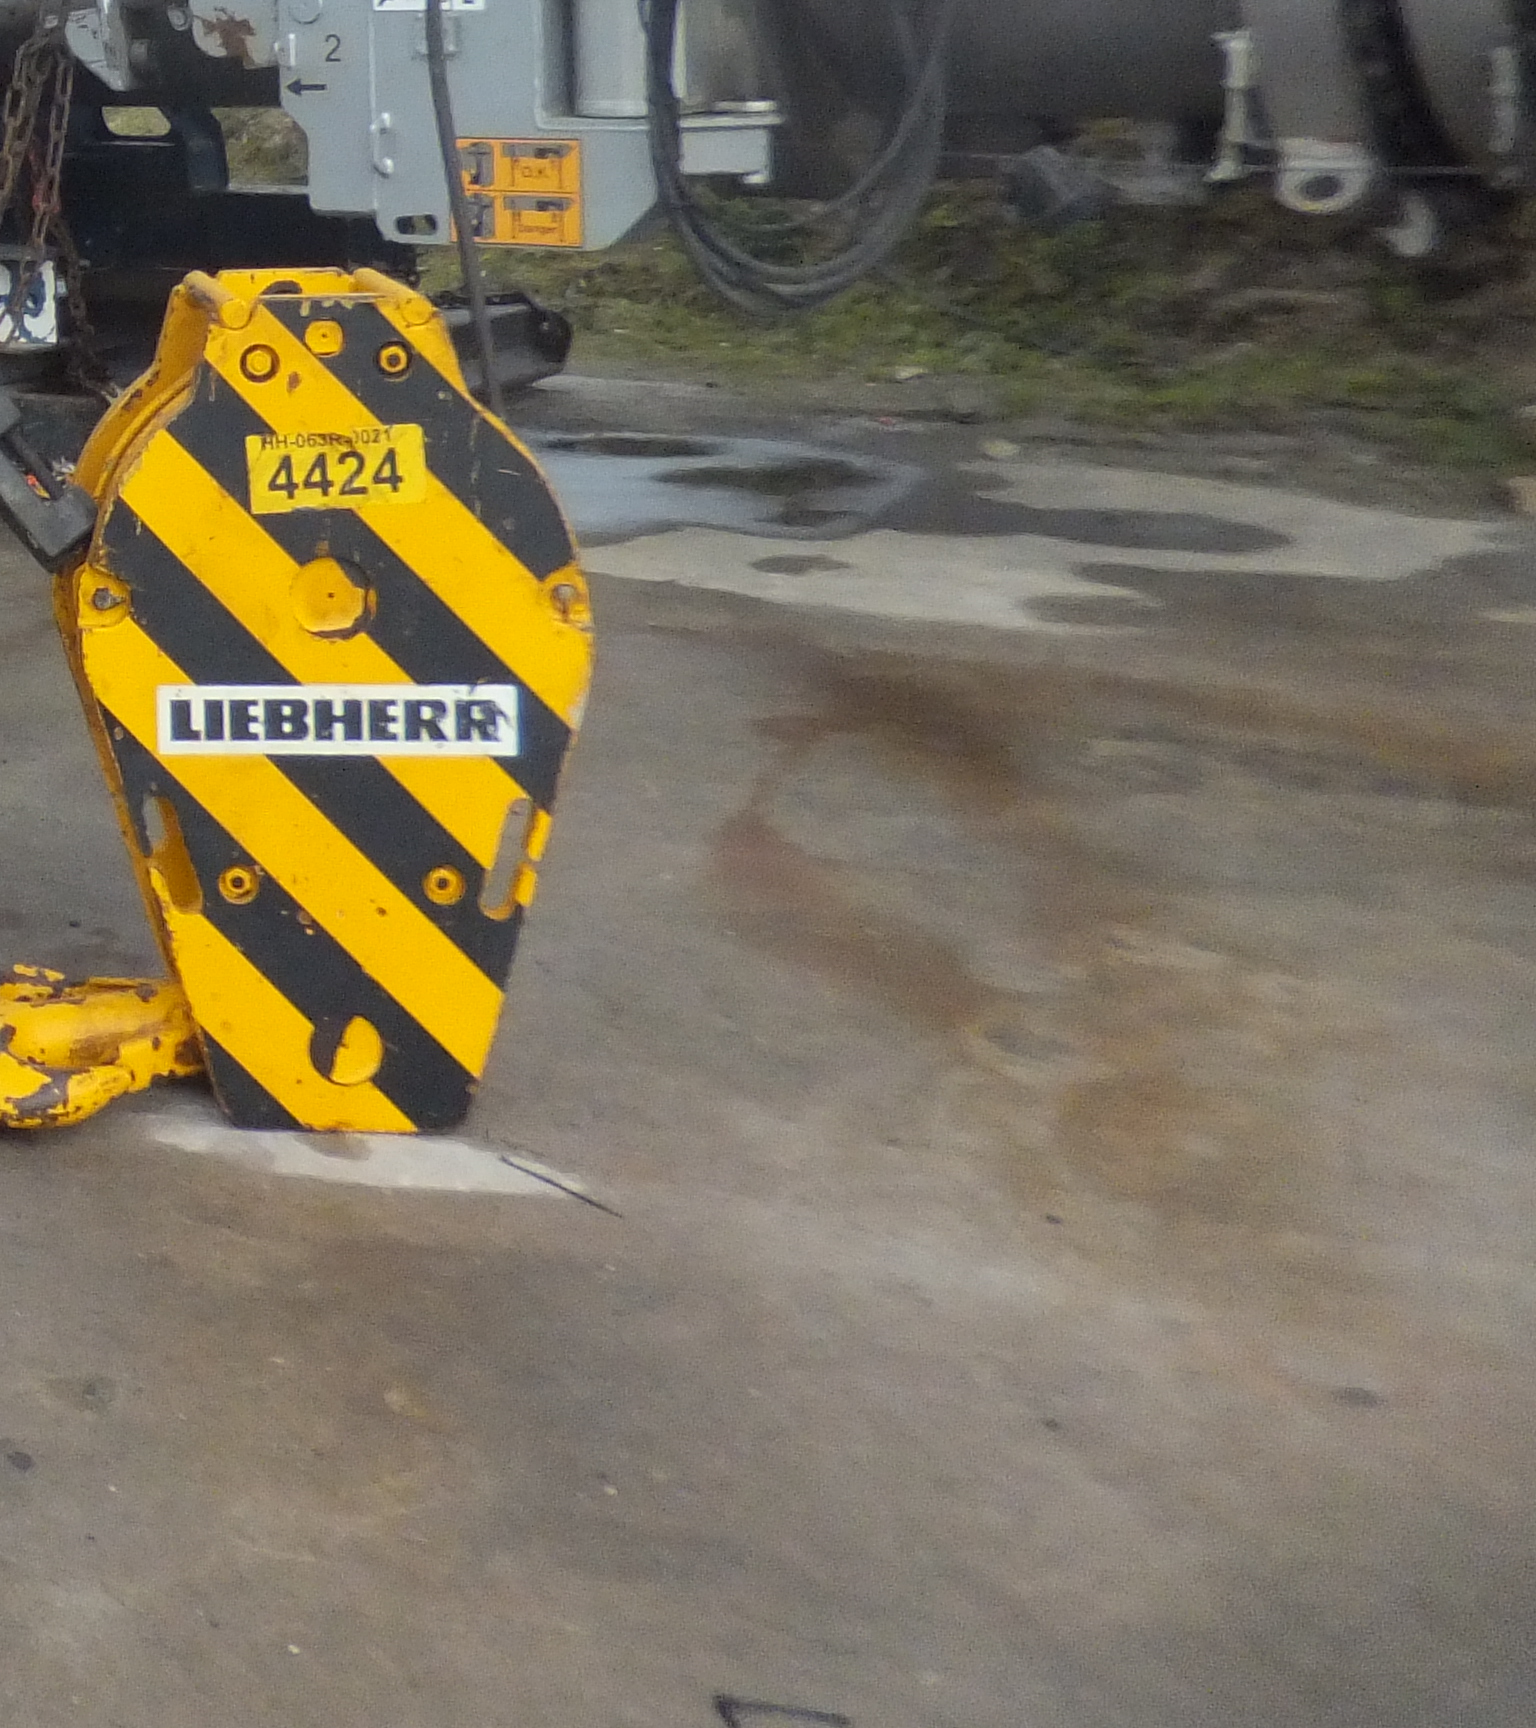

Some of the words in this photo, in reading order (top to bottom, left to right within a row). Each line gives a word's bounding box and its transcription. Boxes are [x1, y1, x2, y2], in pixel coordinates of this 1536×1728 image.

[324, 34, 342, 62] 2
[268, 448, 404, 499] 4424
[169, 699, 506, 742] LIEBHERR
